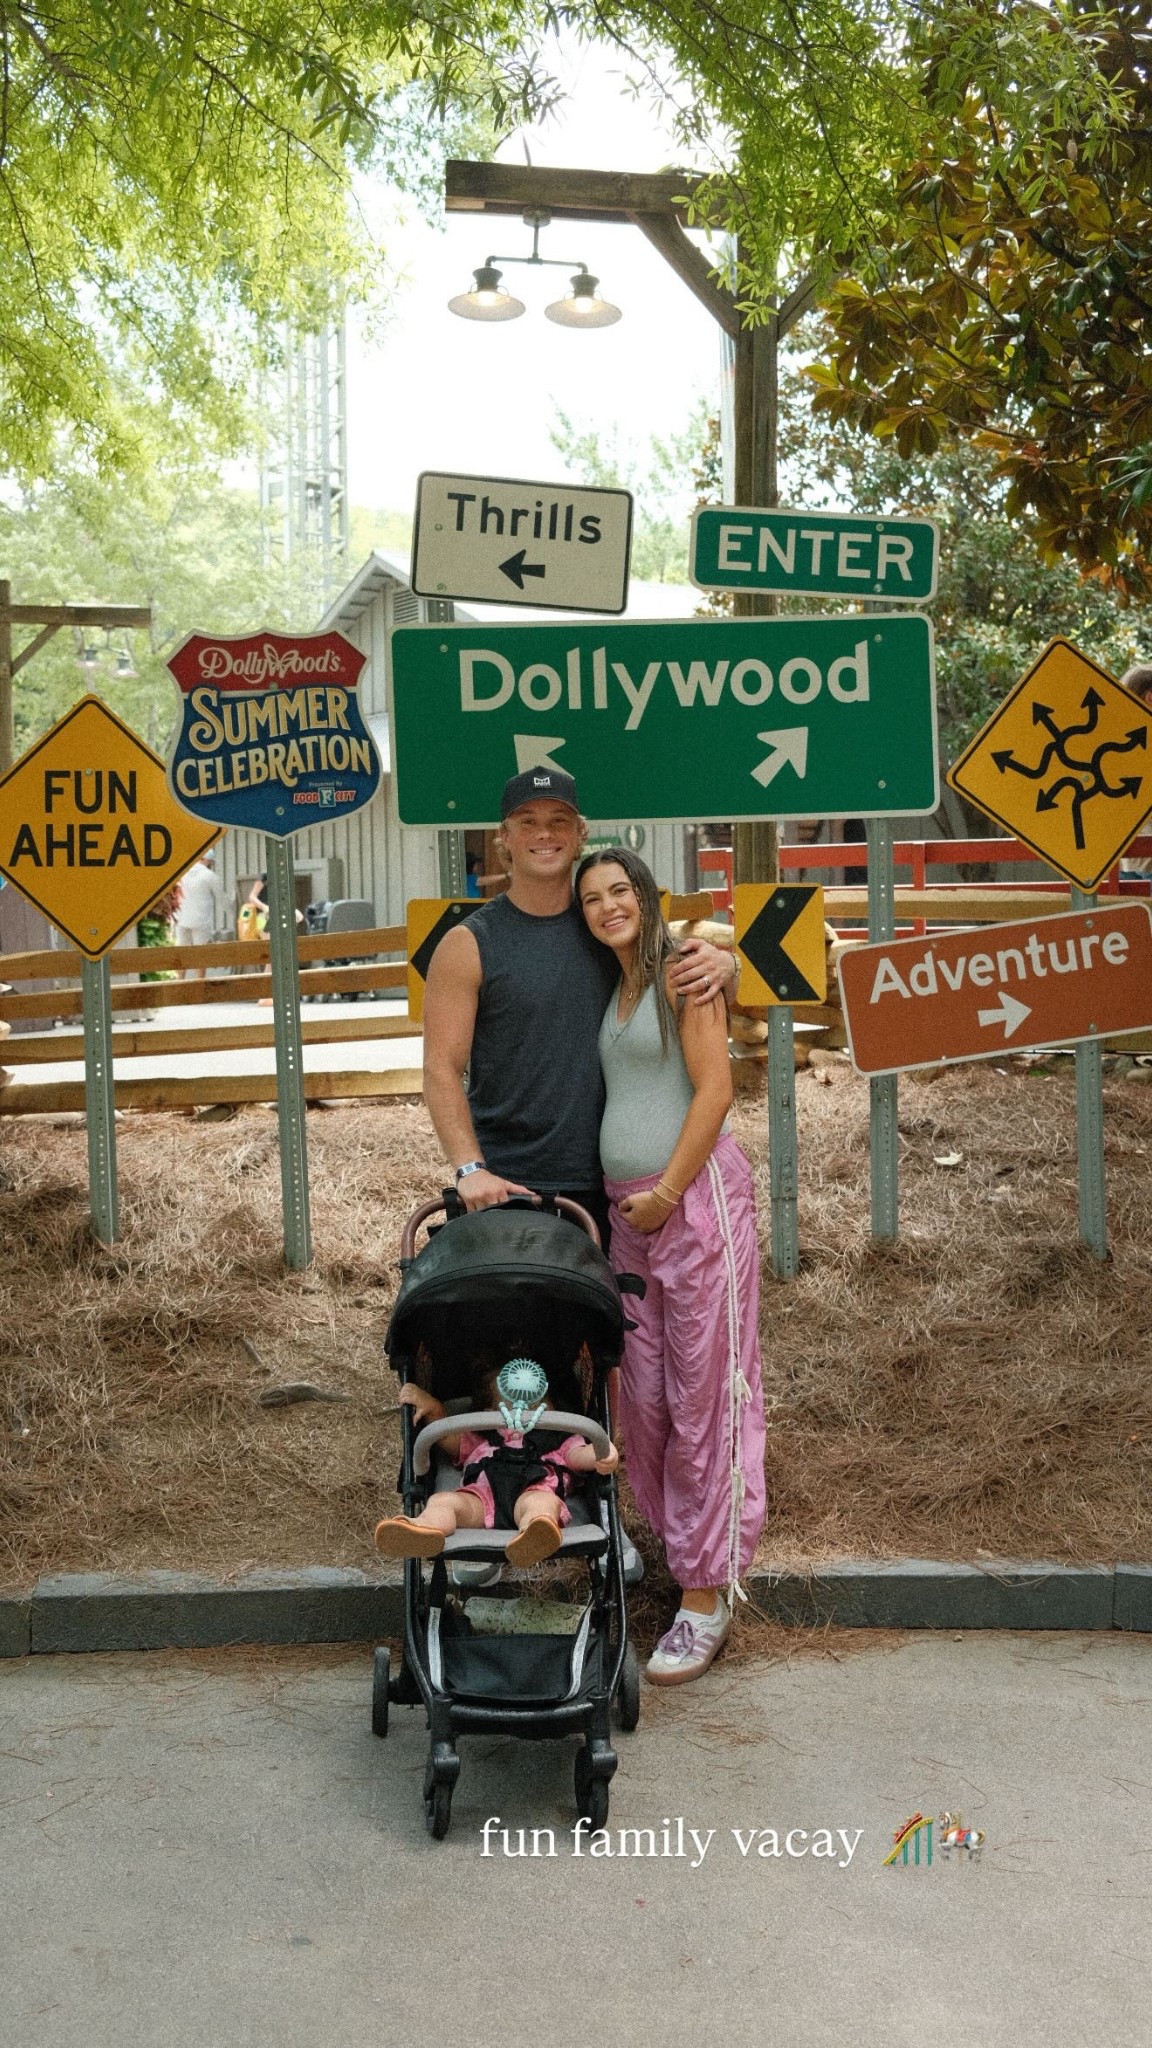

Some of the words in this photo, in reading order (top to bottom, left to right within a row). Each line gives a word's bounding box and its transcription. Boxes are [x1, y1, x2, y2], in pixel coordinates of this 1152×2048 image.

[447, 492, 602, 544] Thrills
[717, 524, 914, 581] ENTER
[459, 640, 870, 730] Dollywood
[188, 687, 351, 752] SUMMER
[44, 770, 137, 814] FUN
[176, 735, 371, 797] CELEBRATION
[293, 792, 319, 805] FOOD
[335, 790, 356, 803] CITY
[9, 824, 173, 867] AHEAD
[869, 931, 1129, 1004] Adventure
